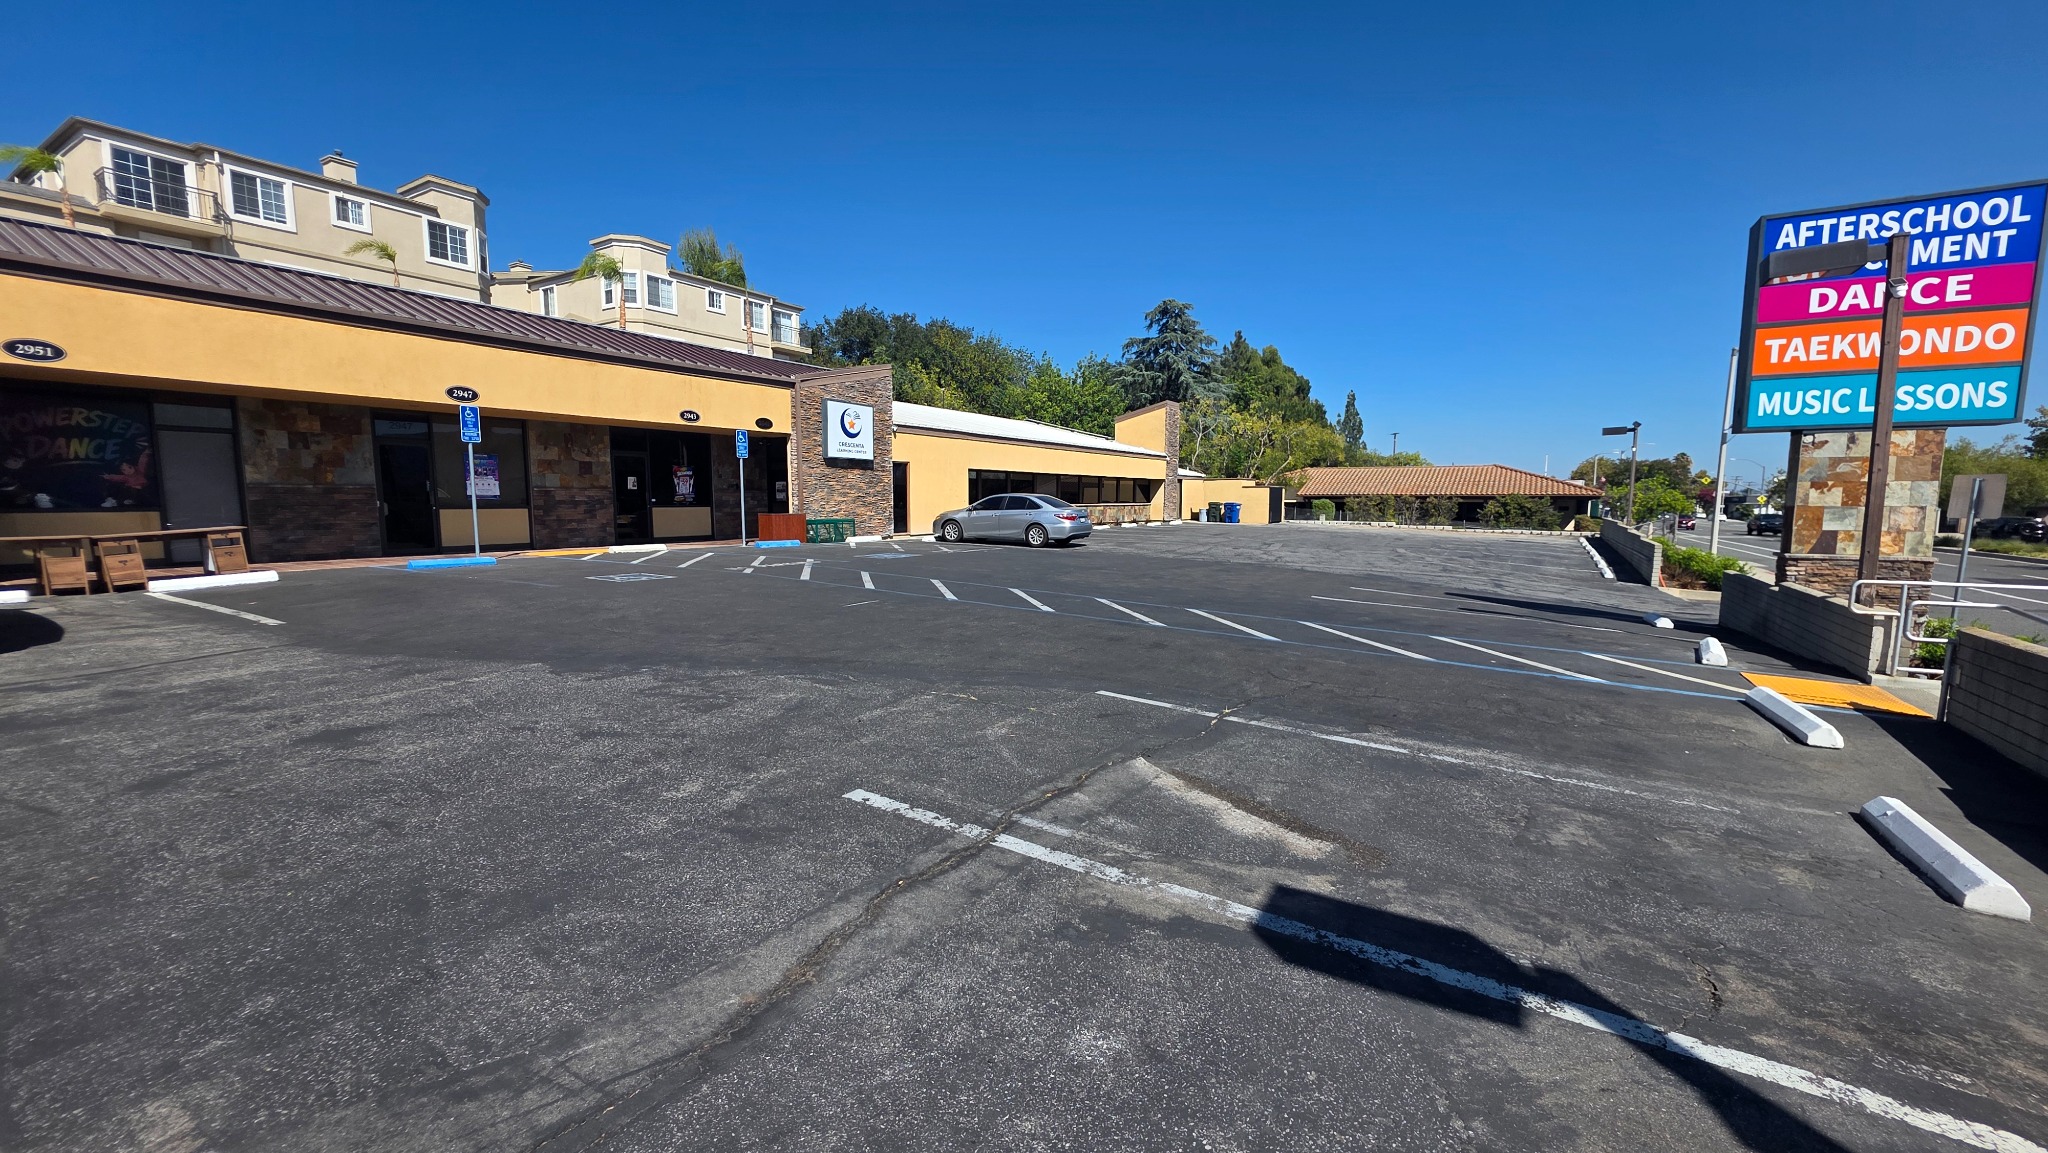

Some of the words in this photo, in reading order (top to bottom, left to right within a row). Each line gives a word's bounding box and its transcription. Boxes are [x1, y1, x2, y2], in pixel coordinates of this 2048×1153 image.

[1775, 195, 2031, 249] AFTERSCHOOL
[15, 343, 54, 357] 2951
[452, 389, 473, 398] 2947
[1757, 387, 1852, 417] MUSIC
[1857, 380, 2009, 414] LSSONS
[26, 435, 123, 460] DANCE
[838, 441, 865, 449] CRESCENTA
